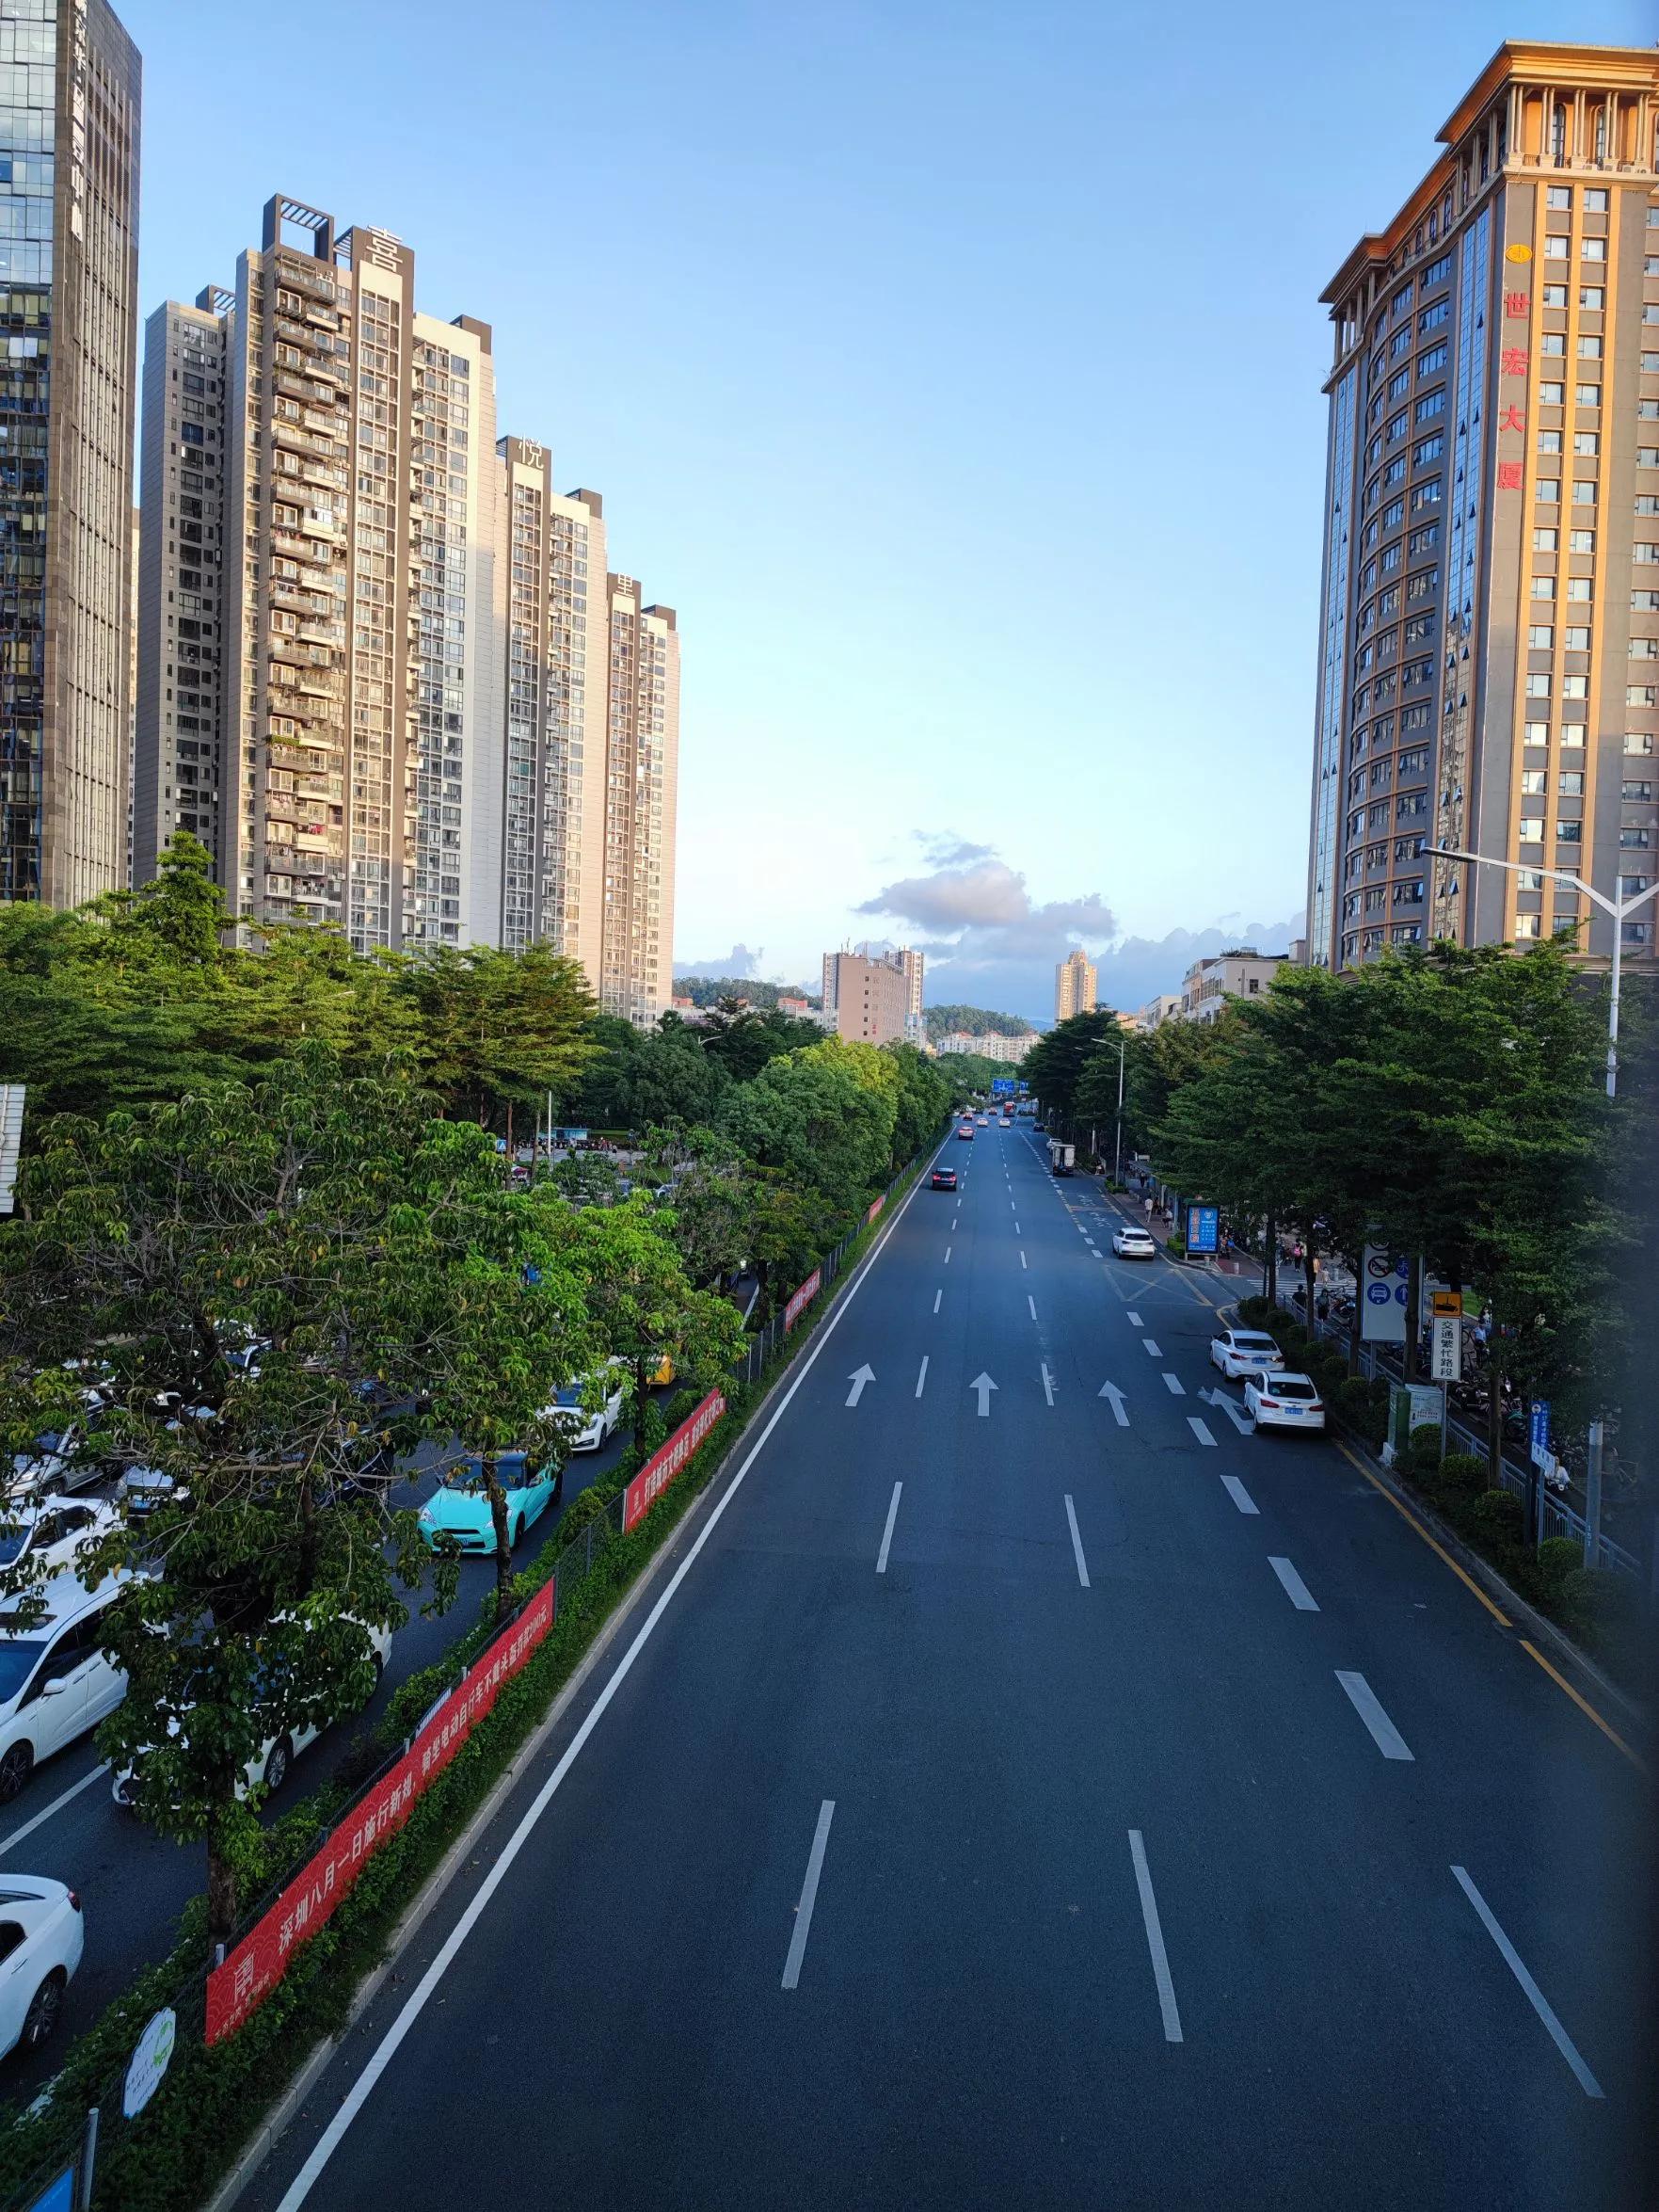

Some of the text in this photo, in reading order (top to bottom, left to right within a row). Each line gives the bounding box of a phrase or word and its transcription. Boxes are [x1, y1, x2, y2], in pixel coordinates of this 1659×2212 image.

[366, 224, 404, 273] 喜
[1497, 292, 1531, 490] 世宏大厦
[518, 433, 545, 470] 悦
[615, 572, 635, 598] 里
[1440, 1320, 1454, 1377] 交通繁忙路段
